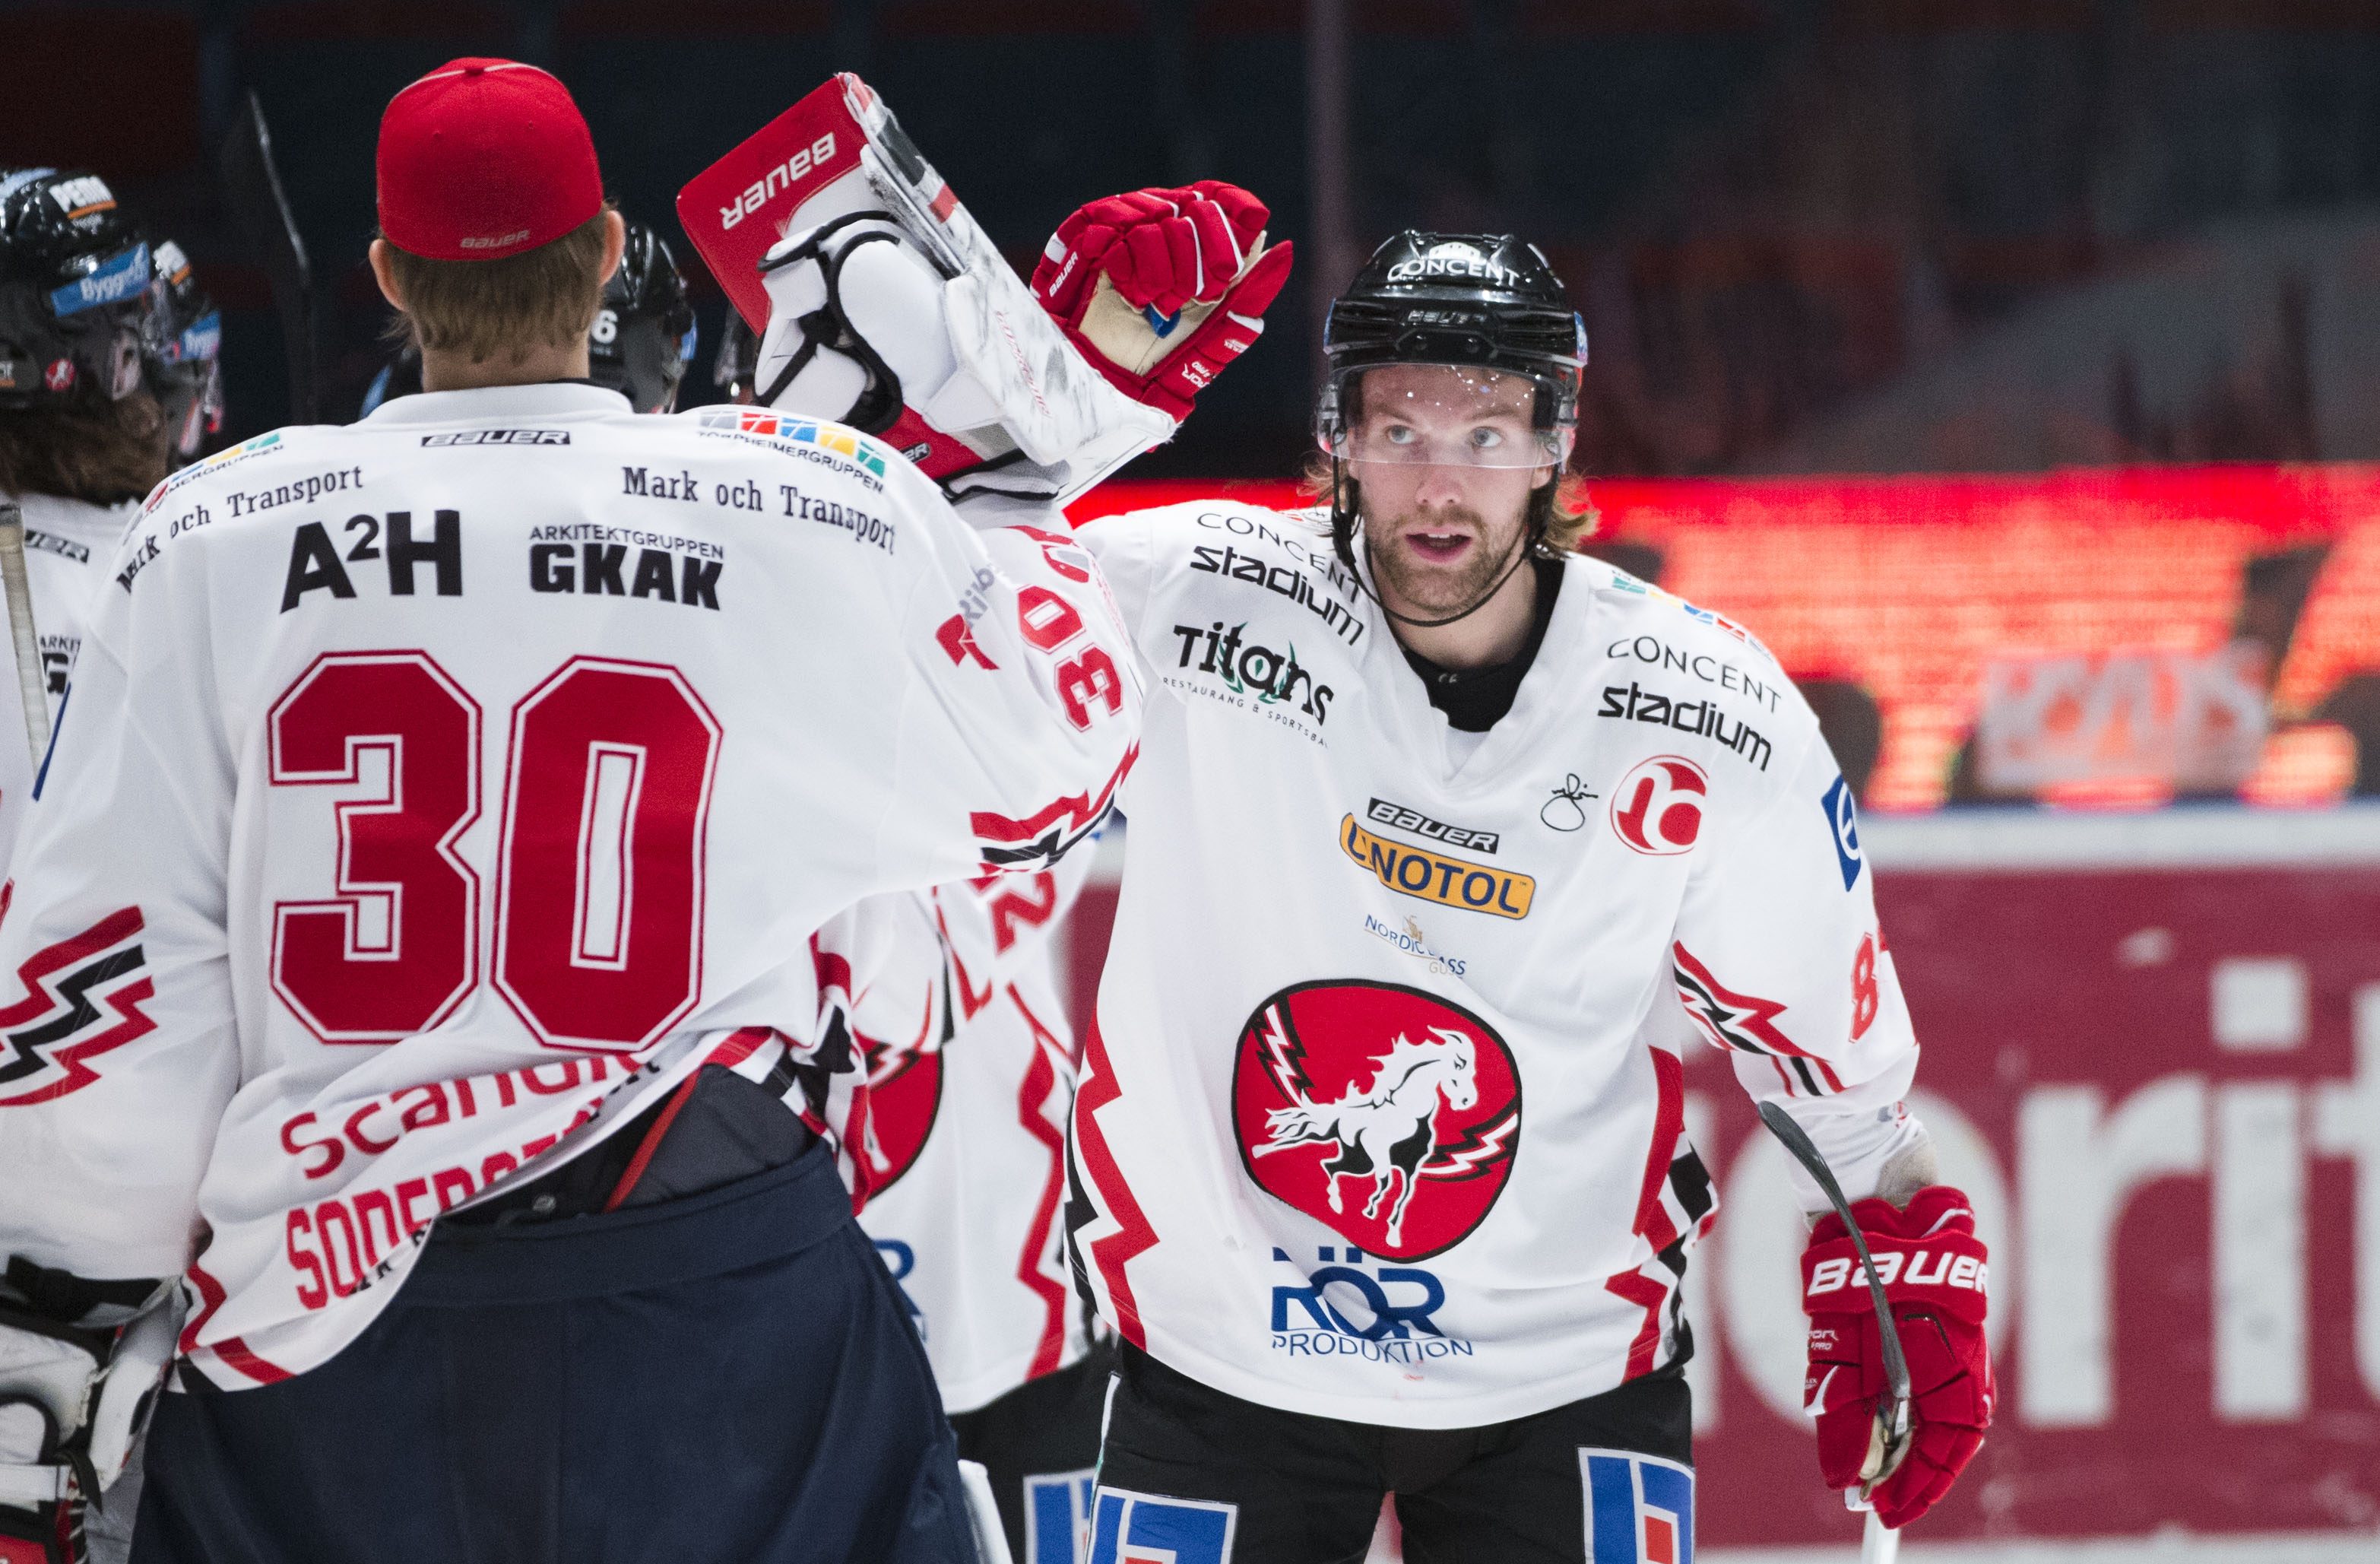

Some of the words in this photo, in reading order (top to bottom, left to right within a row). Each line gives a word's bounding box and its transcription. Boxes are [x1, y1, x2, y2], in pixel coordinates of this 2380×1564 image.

[720, 133, 836, 229] BAUER
[461, 230, 529, 249] BAUER
[1048, 251, 1079, 298] BAUER
[1386, 259, 1520, 287] CONCENT
[426, 431, 568, 446] BAUER
[116, 535, 161, 594] Mark
[170, 505, 211, 538] och
[227, 465, 363, 519] Transport
[530, 523, 724, 560] ARKITEKTGRUPPEN
[623, 466, 698, 503] Mark
[716, 480, 763, 512] och
[779, 484, 896, 555] Transport
[529, 542, 723, 611] GKAK
[1189, 544, 1364, 646] stadium
[1196, 512, 1360, 604] CONCENT
[1015, 582, 1123, 733] 30
[1162, 677, 1244, 709] RESTAURANG
[1173, 620, 1334, 727] Titans
[1606, 635, 1782, 714] CONCENT
[1597, 681, 1772, 772] stadium
[267, 649, 723, 1052] 30
[1369, 801, 1497, 852] BAUER
[1272, 1333, 1473, 1363] PRODUKTION
